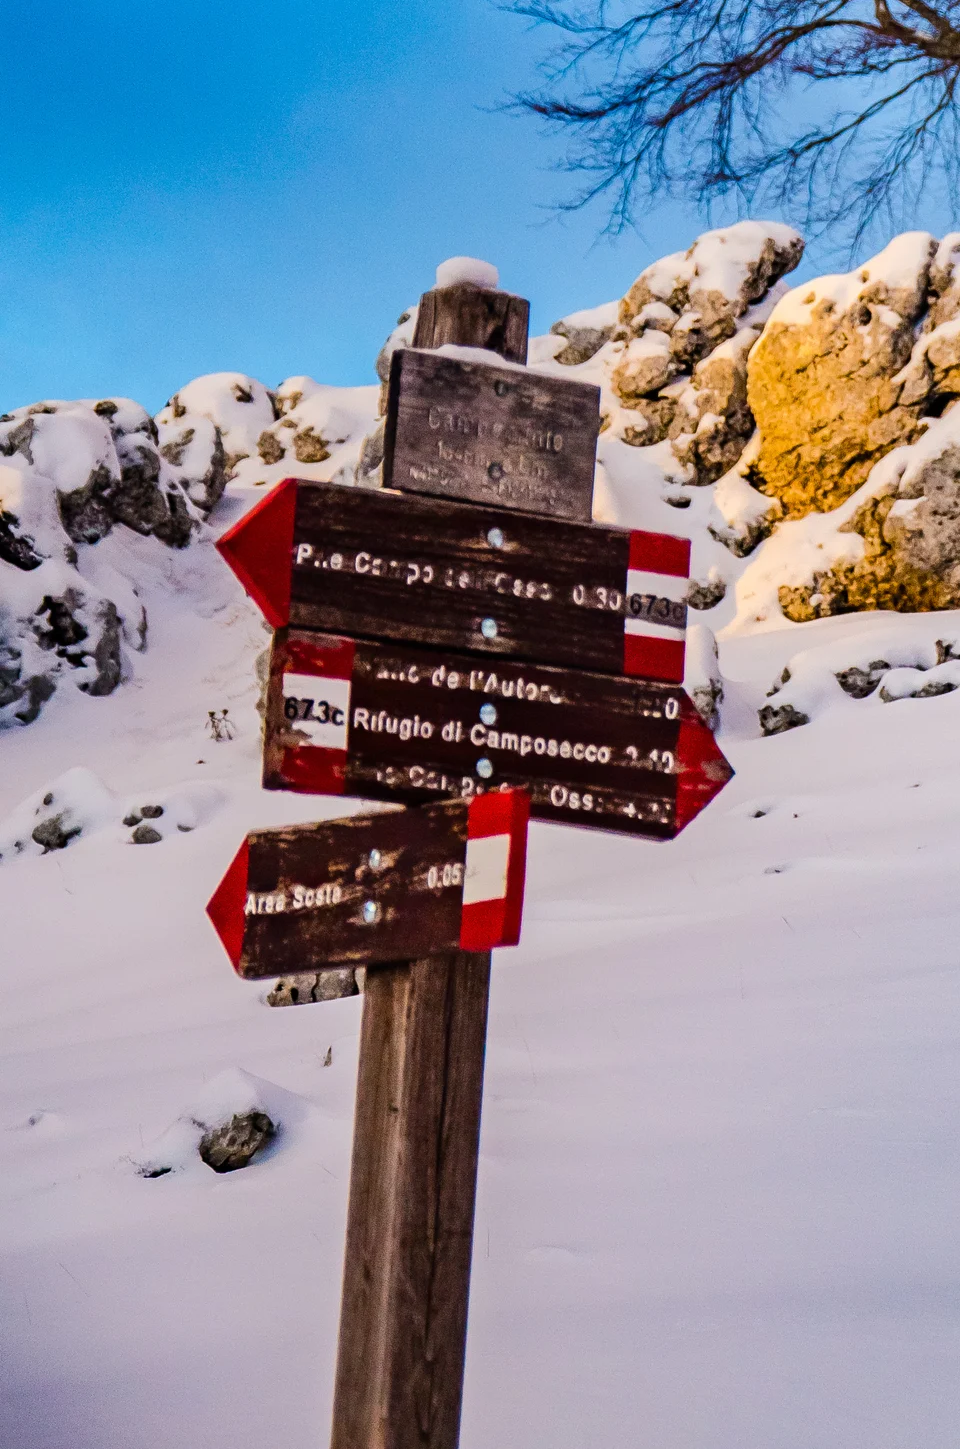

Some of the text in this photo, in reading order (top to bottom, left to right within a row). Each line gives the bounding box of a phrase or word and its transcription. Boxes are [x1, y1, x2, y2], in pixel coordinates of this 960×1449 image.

[355, 551, 434, 585] Capo
[432, 665, 460, 690] de
[284, 696, 344, 726] 673c
[353, 707, 433, 740] Rifugio
[441, 720, 463, 743] di
[470, 723, 611, 764] Camposecco
[245, 893, 287, 916] Area
[427, 862, 462, 889] 0.05
